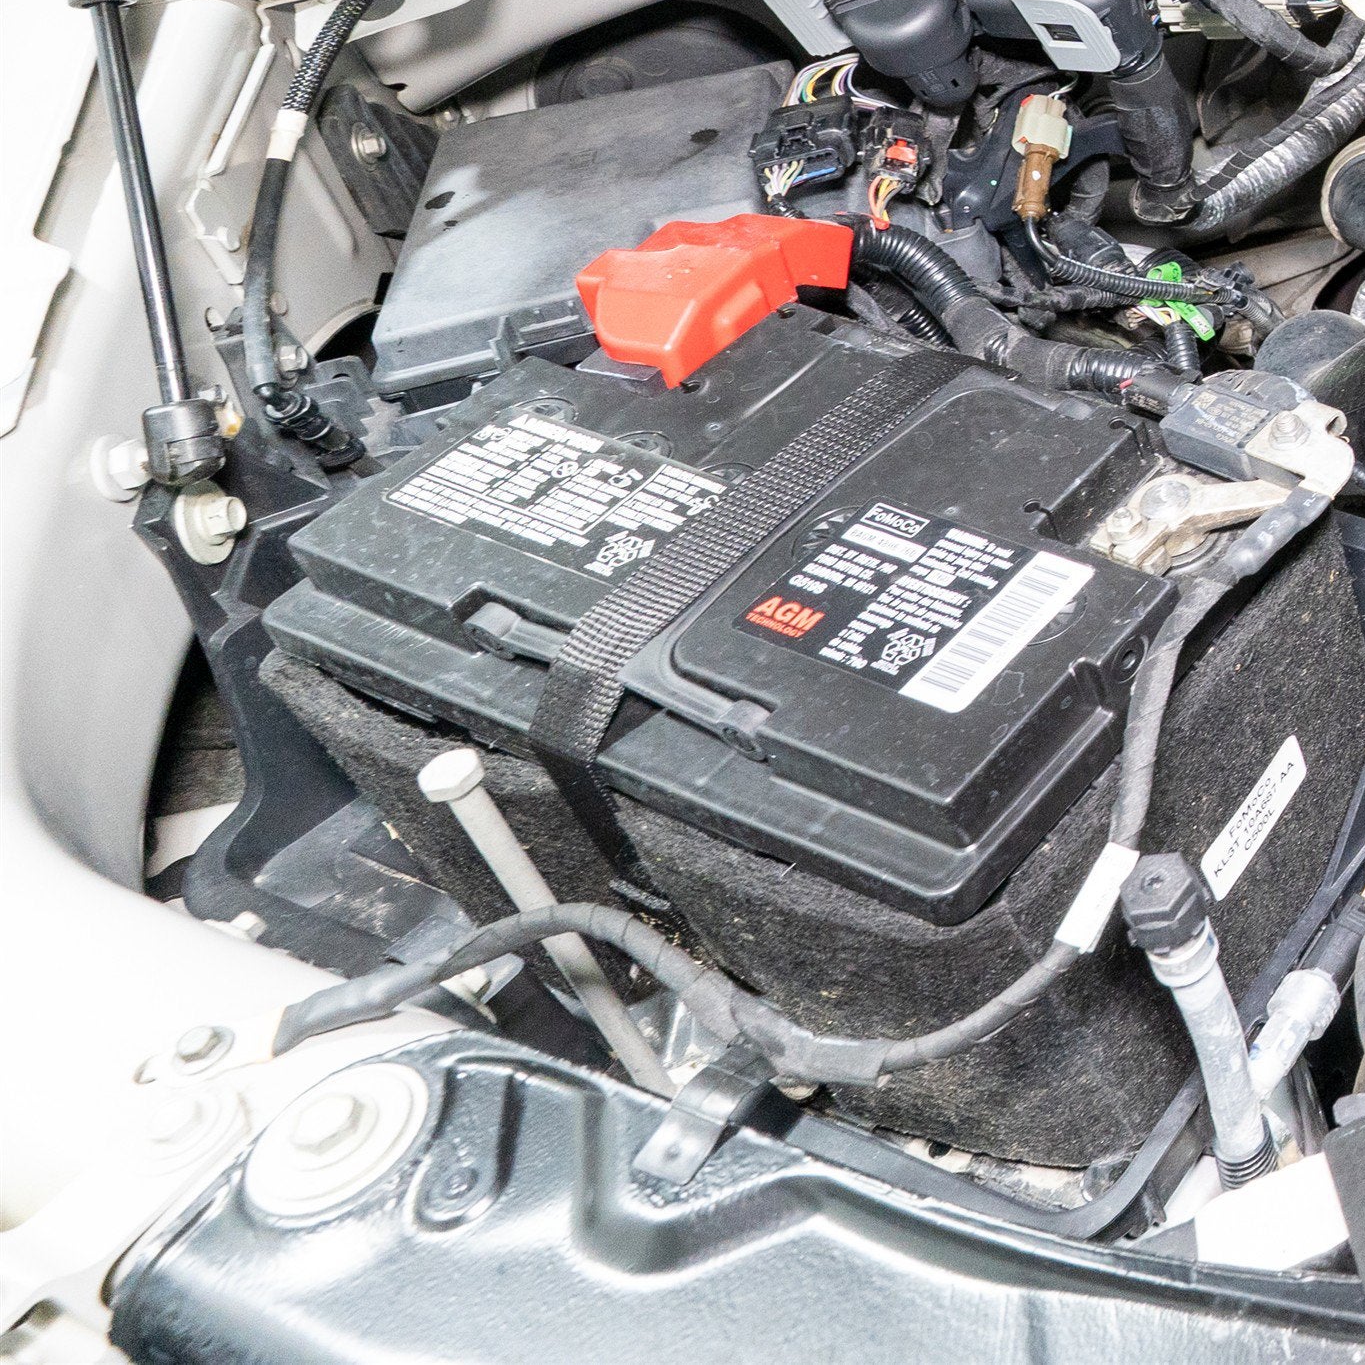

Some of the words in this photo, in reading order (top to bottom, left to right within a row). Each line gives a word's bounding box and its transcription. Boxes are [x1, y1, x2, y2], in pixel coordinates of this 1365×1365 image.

[865, 508, 921, 534] FoMoCo
[746, 611, 805, 637] TECHNOLOGY
[753, 596, 825, 632] AGM
[1280, 761, 1294, 783] AA
[1229, 777, 1271, 839] FoMoCo
